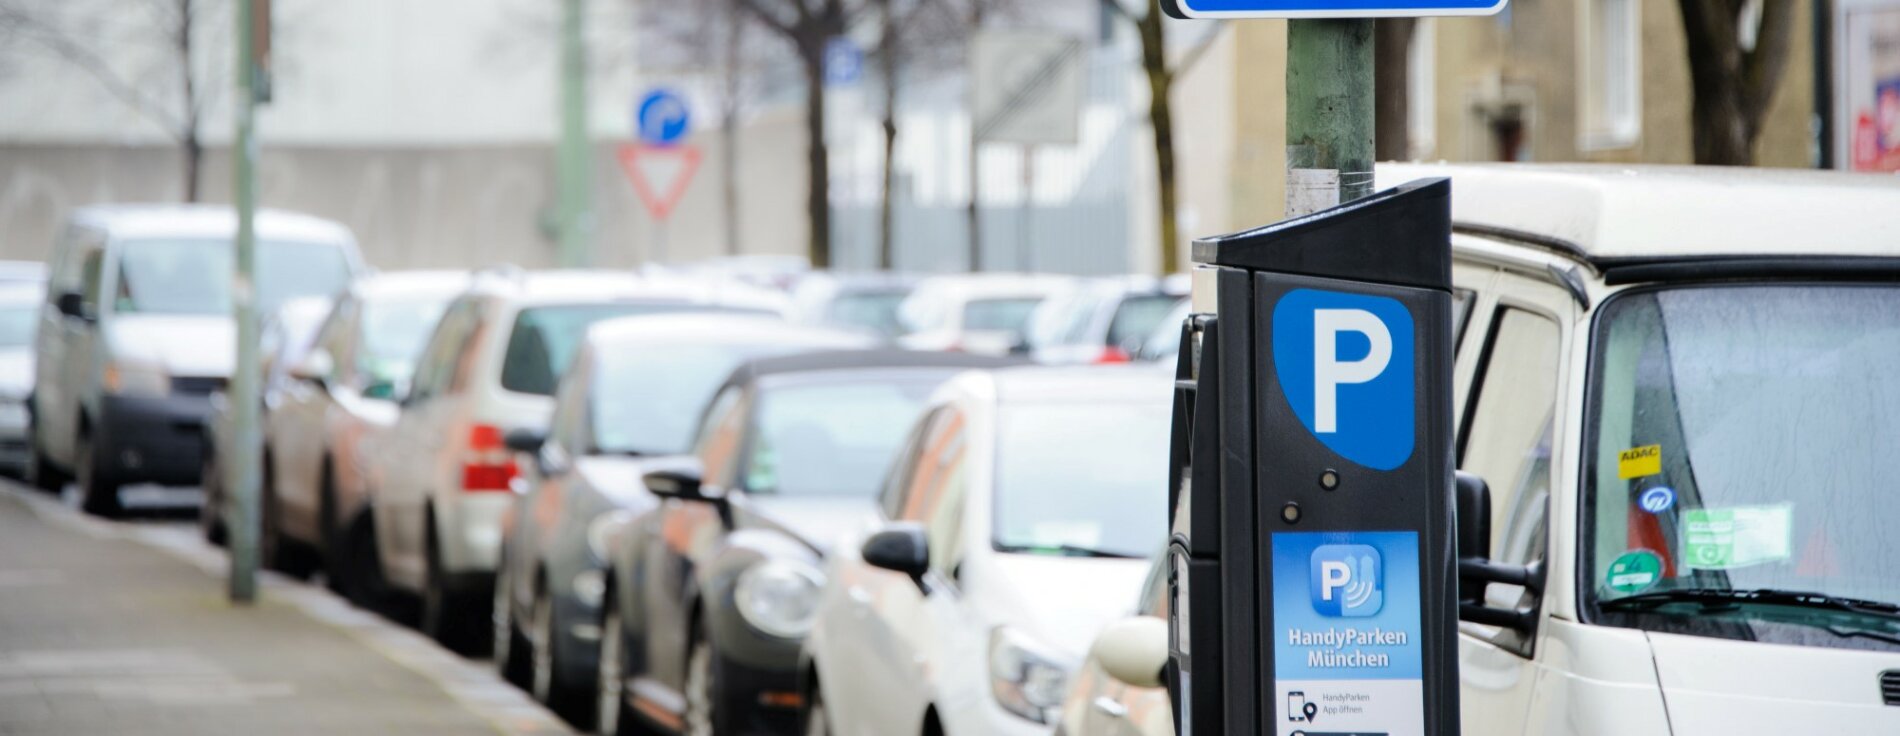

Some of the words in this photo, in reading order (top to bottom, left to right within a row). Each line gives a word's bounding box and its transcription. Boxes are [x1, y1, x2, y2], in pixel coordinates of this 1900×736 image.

[1314, 308, 1393, 433] P
[1621, 446, 1658, 461] ADAC
[1322, 560, 1351, 601] P
[1288, 626, 1407, 649] HandyParken
[1307, 649, 1390, 668] München
[1322, 693, 1370, 703] HandyParken
[1322, 706, 1337, 715] App
[1339, 705, 1363, 714] öffnen
